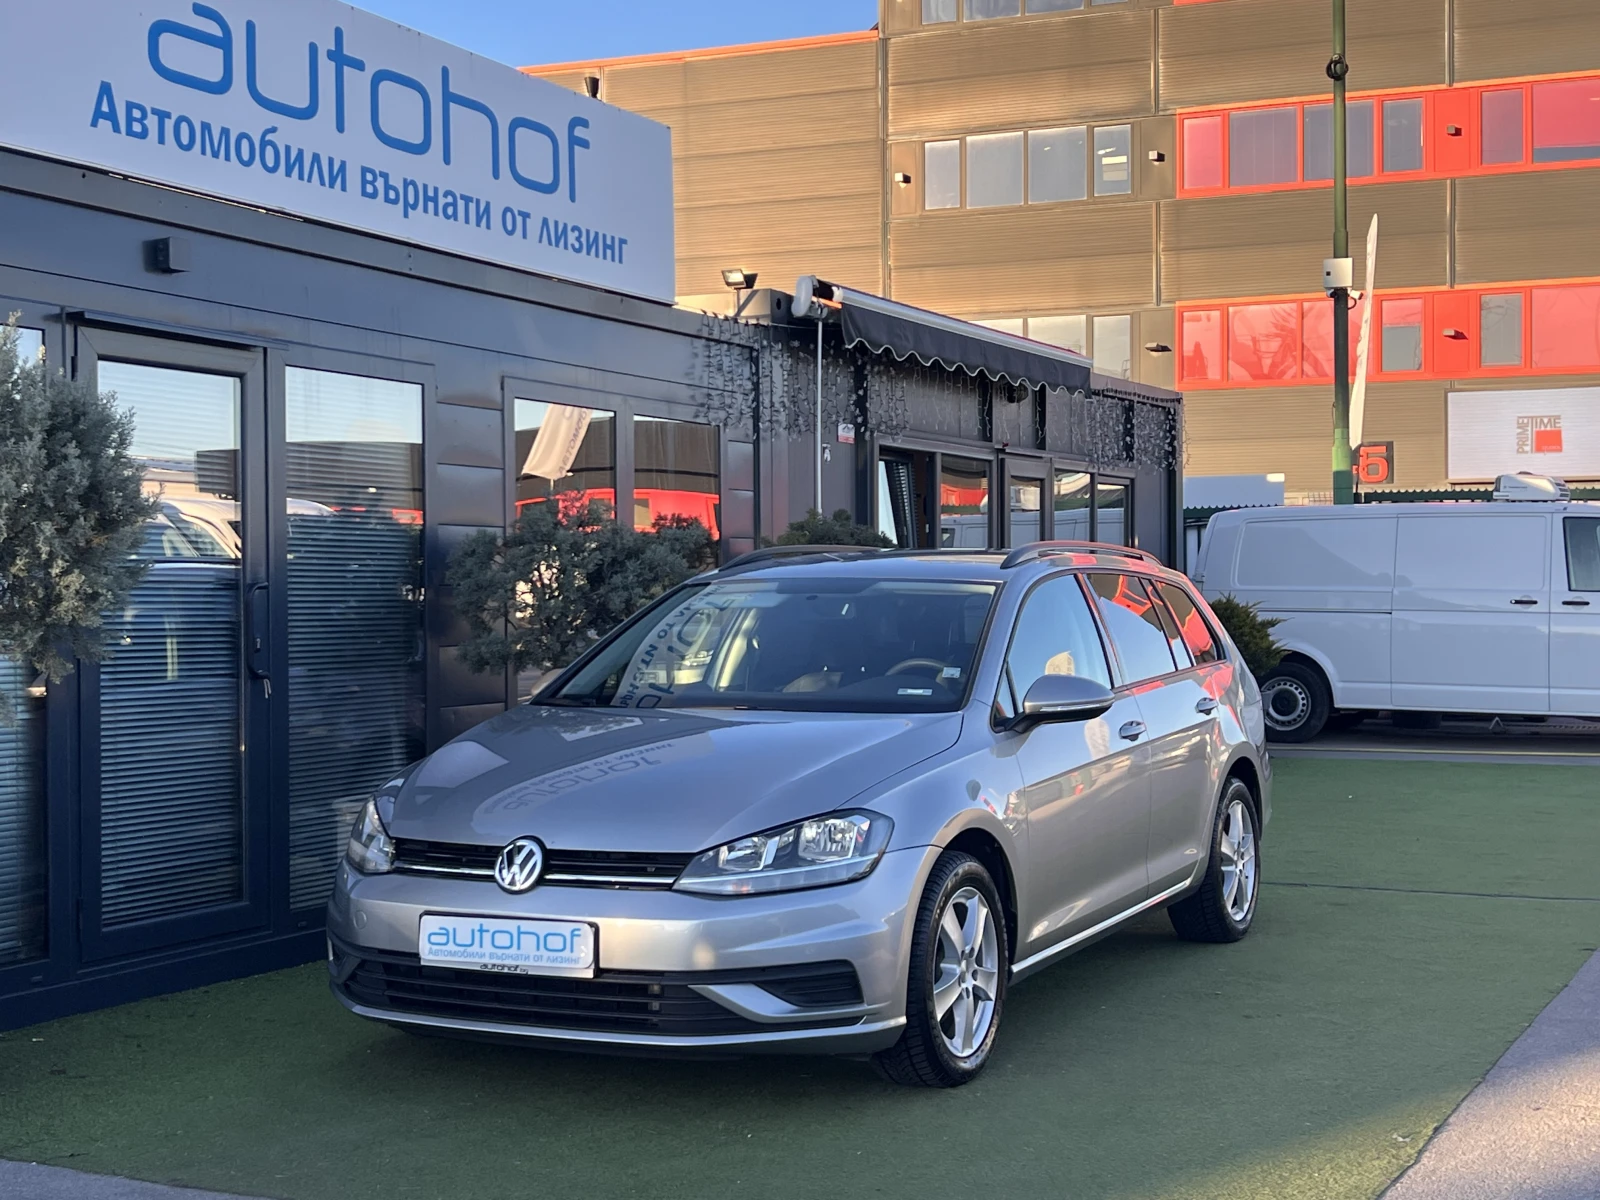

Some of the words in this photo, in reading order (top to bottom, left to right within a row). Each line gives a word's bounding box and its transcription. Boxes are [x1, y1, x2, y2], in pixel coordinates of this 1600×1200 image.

[148, 2, 590, 203] autohof
[90, 80, 348, 192] Автомобили
[360, 165, 492, 230] върнати
[502, 206, 532, 240] от
[538, 216, 628, 264] лизинг
[1516, 416, 1529, 454] PRIME
[427, 923, 582, 954] autohof
[427, 947, 486, 959] Автомобили
[489, 951, 531, 962] върнати
[533, 954, 543, 962] от
[546, 955, 582, 965] лизинг
